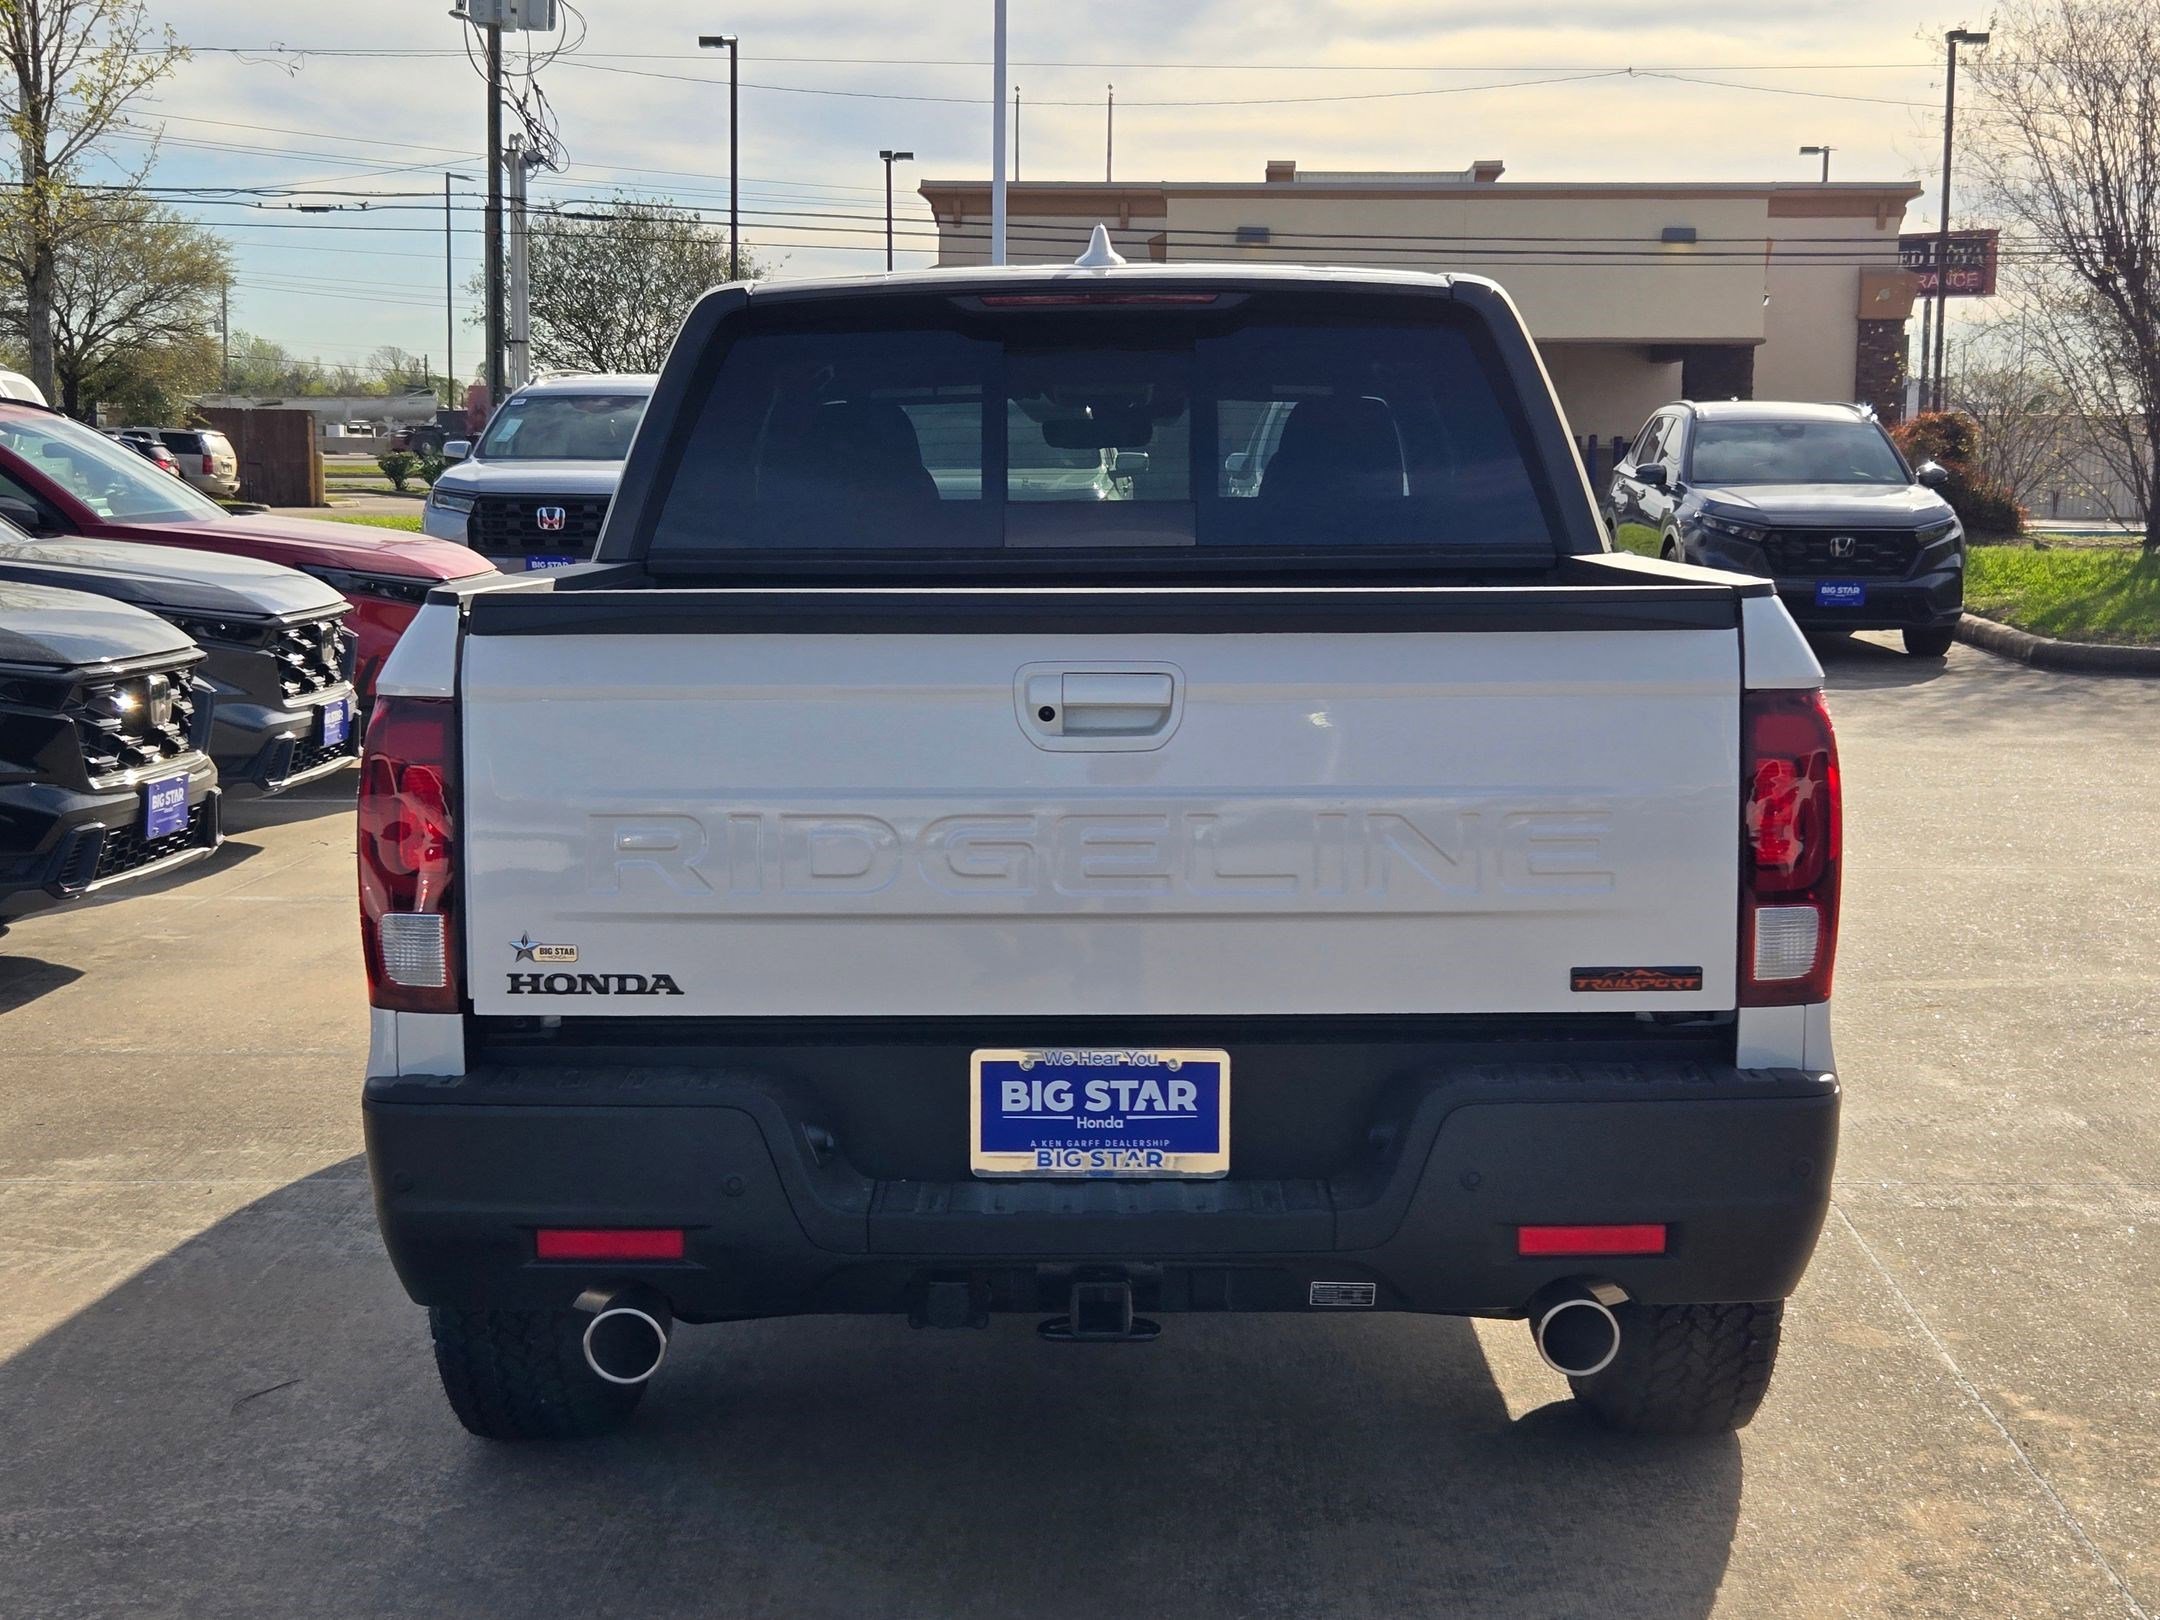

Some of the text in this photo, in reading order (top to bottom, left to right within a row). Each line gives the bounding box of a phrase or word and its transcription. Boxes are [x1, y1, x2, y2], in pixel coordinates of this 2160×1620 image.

[1821, 586, 1861, 594] BIG STAR
[152, 788, 184, 809] BIG STAR
[587, 811, 1613, 897] RIDGELINE
[539, 947, 575, 956] BIG STAR
[506, 973, 685, 995] HONDA
[1044, 1051, 1158, 1065] We Hear You
[1001, 1080, 1198, 1112] BIG STAR
[1076, 1116, 1124, 1129] Honda
[1037, 1151, 1163, 1167] BIG STAR
